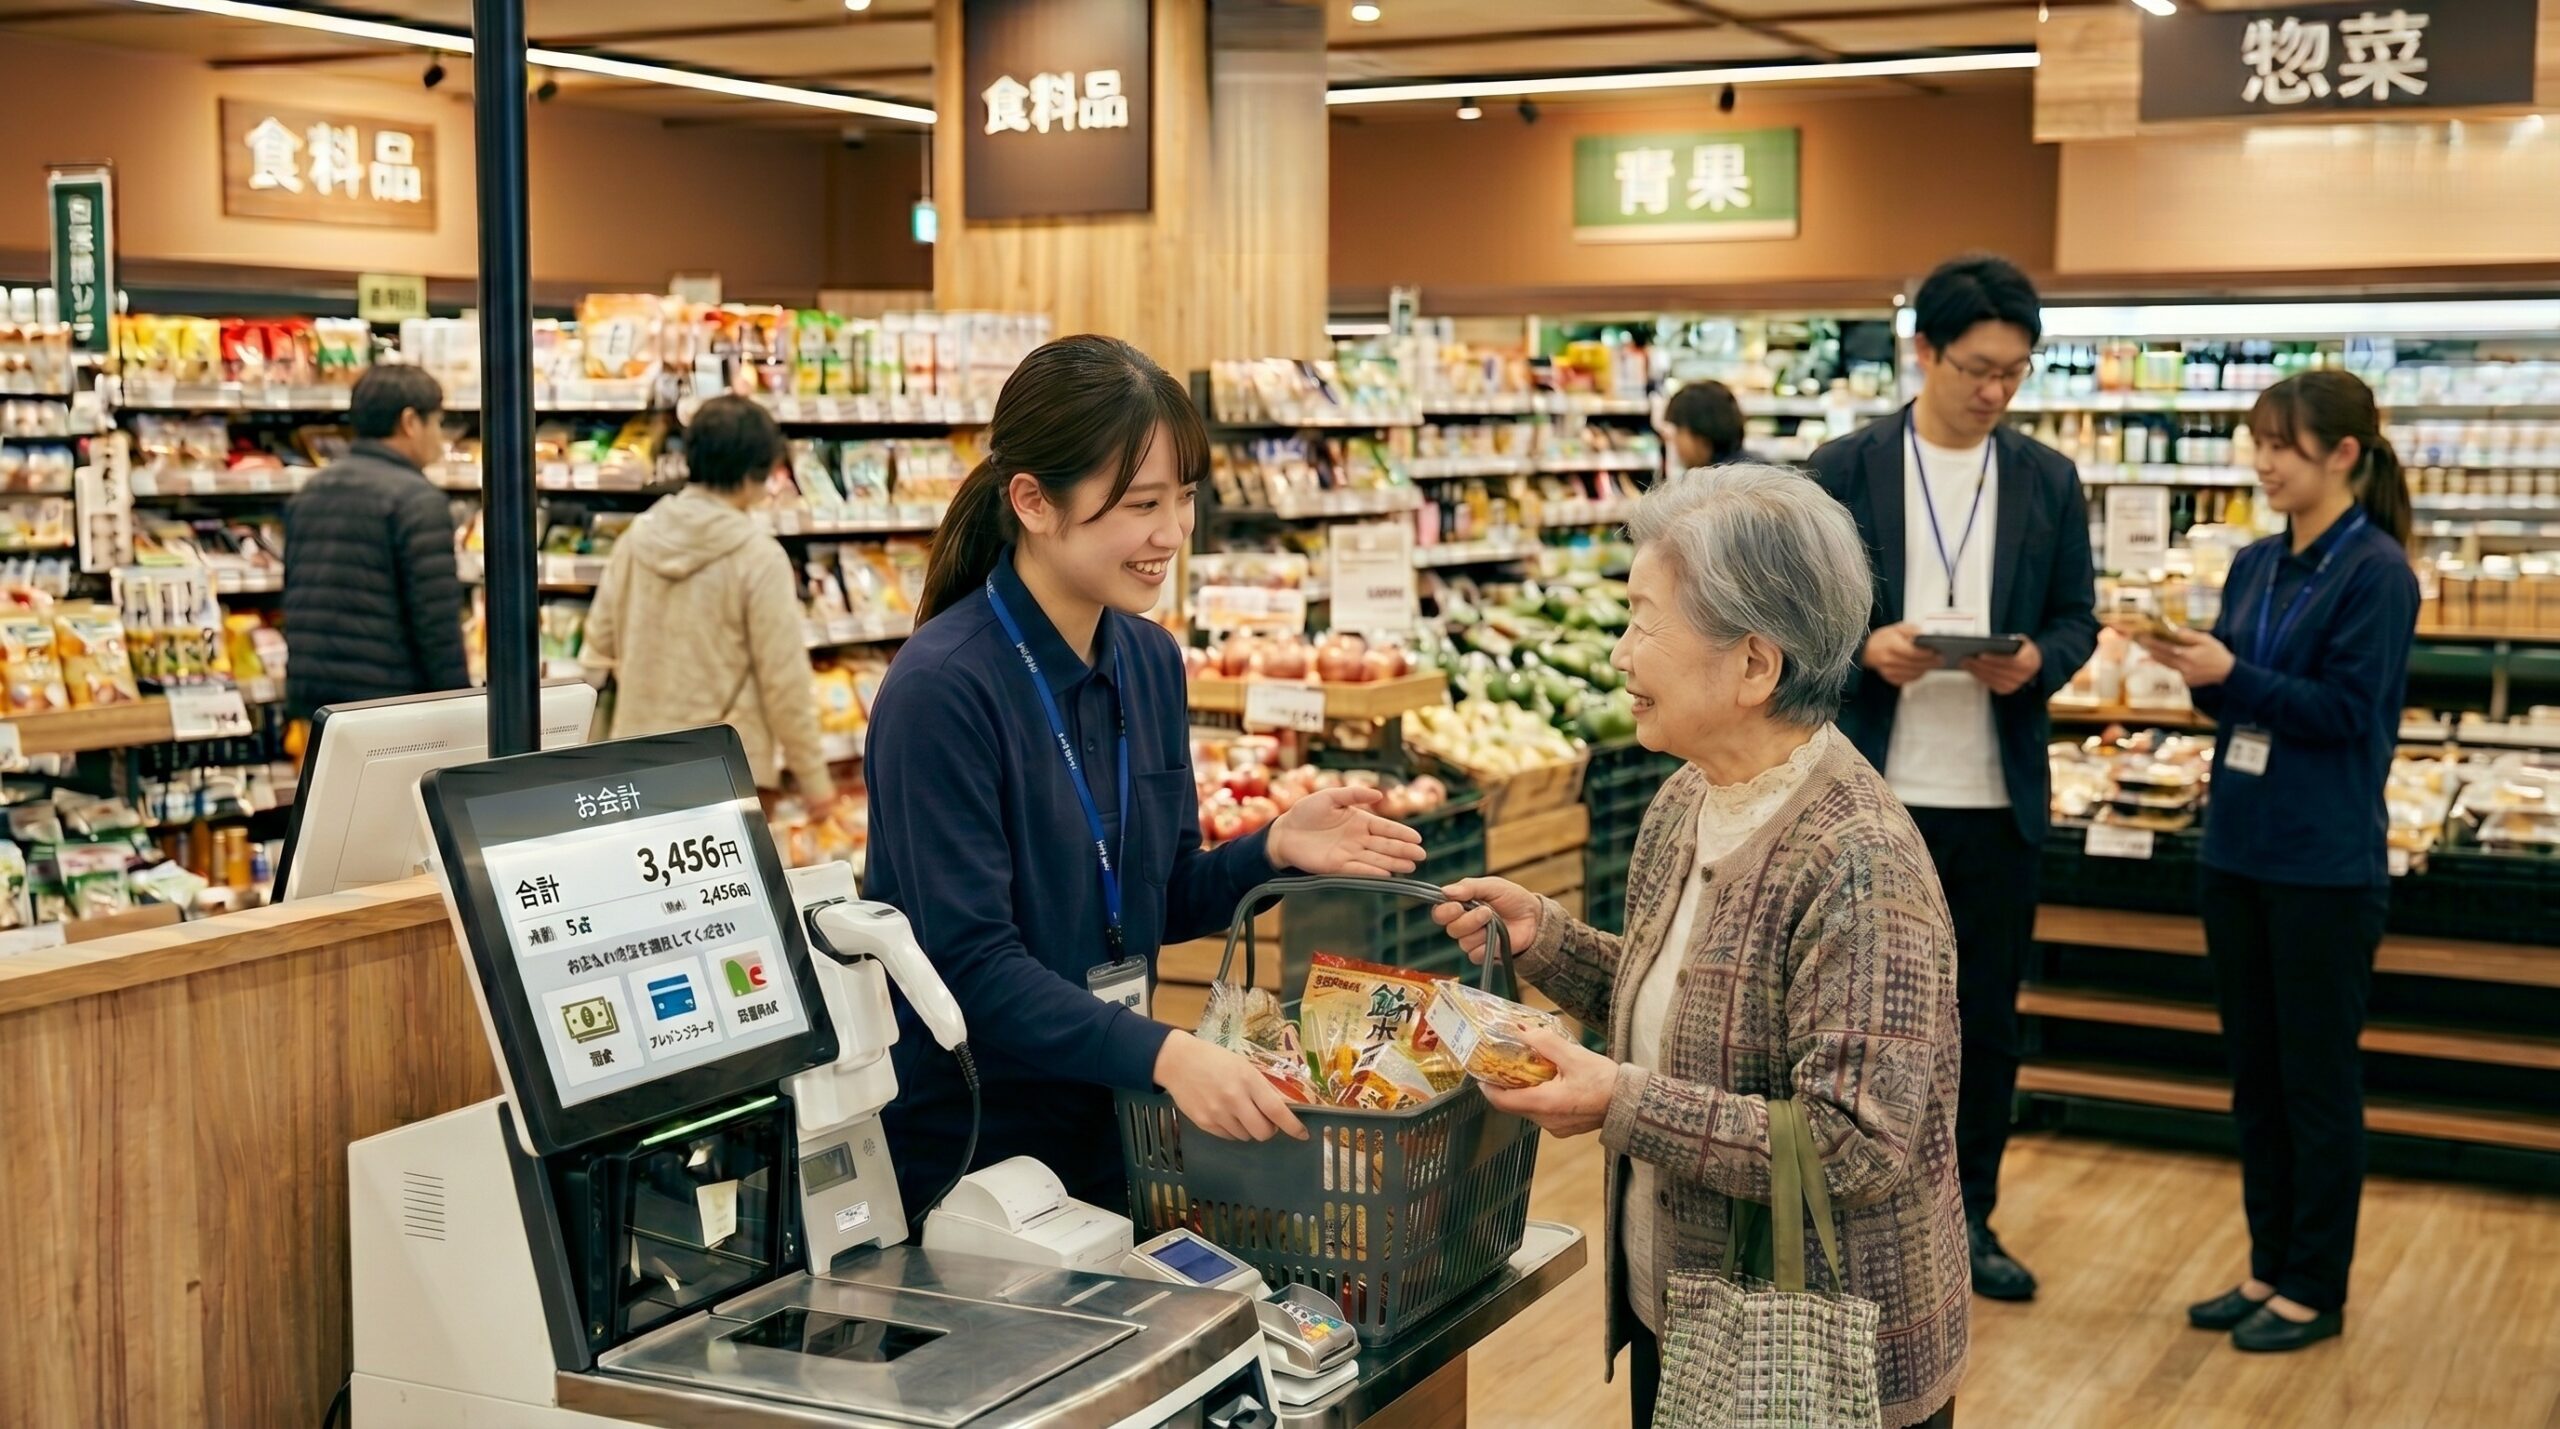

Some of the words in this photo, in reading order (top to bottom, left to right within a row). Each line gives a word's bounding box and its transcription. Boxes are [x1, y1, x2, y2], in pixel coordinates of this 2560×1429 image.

[2242, 9, 2430, 104] 惣菜
[981, 70, 1129, 135] 食料品
[244, 116, 422, 203] 食料品
[1614, 143, 1752, 215] 青果
[575, 782, 640, 819] お会計
[515, 874, 560, 910] 合計
[637, 835, 742, 887] 3,456円
